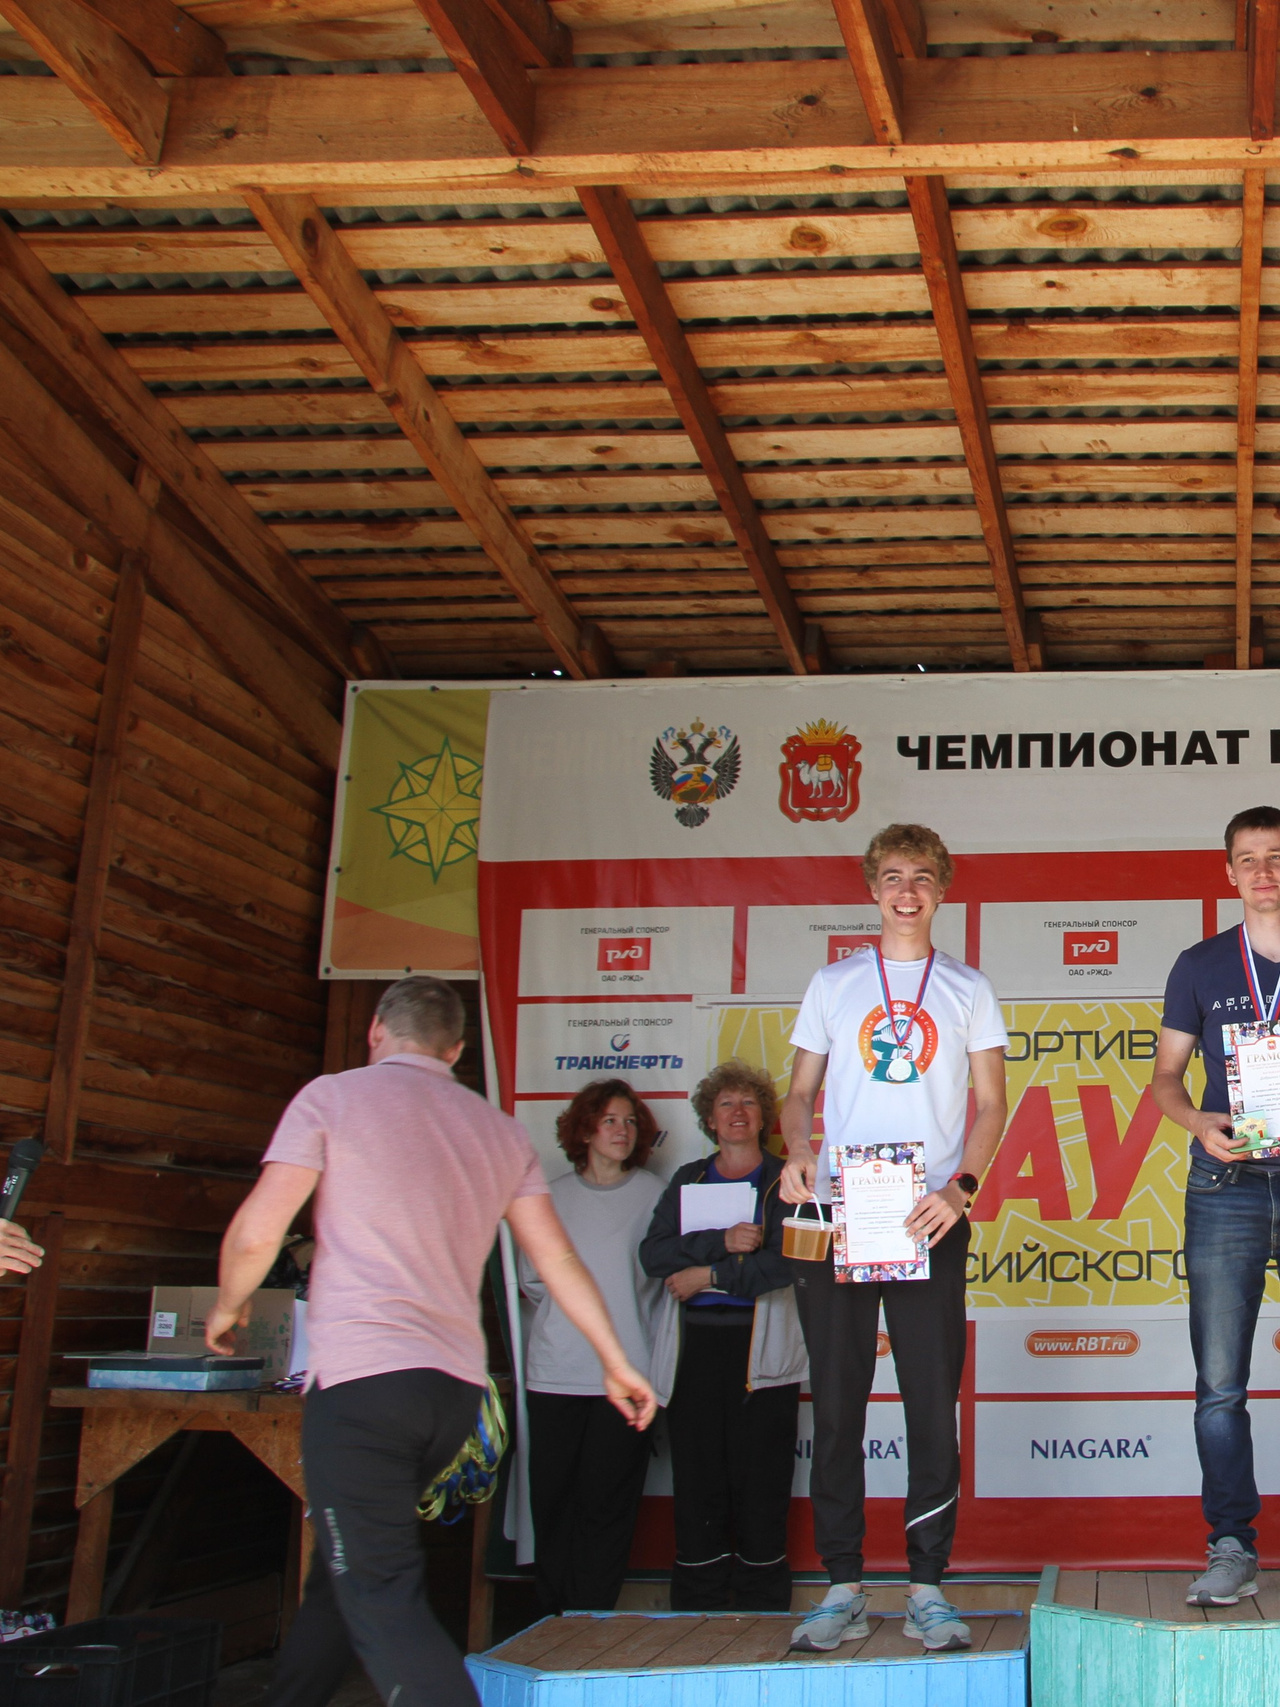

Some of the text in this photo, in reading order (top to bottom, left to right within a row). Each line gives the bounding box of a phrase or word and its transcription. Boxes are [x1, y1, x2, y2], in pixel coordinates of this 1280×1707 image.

[896, 729, 1250, 771] ЧЕМПИОНАТ
[808, 922, 864, 931] ГЕНЕРАЛЬНЫЙ
[1043, 919, 1138, 928] ГЕНЕРАЛЬНЫЙ СПОНСОР
[580, 925, 670, 935] ГЕНЕРАЛЬНЫЙ СПОНСОР
[1068, 968, 1085, 976] ОАО
[601, 974, 645, 982] ОАО «РЖД»
[567, 1017, 673, 1027] ГЕНЕРАЛЬНЫЙ СПОНСОР
[554, 1055, 684, 1070] ТРАНСНЕФТЬ
[851, 1175, 905, 1186] ГРАМОТА
[965, 1243, 1190, 1284] ИЙСКОГ
[1034, 1336, 1127, 1352] www.RBT.ru
[1031, 1438, 1150, 1460] NIAGARA
